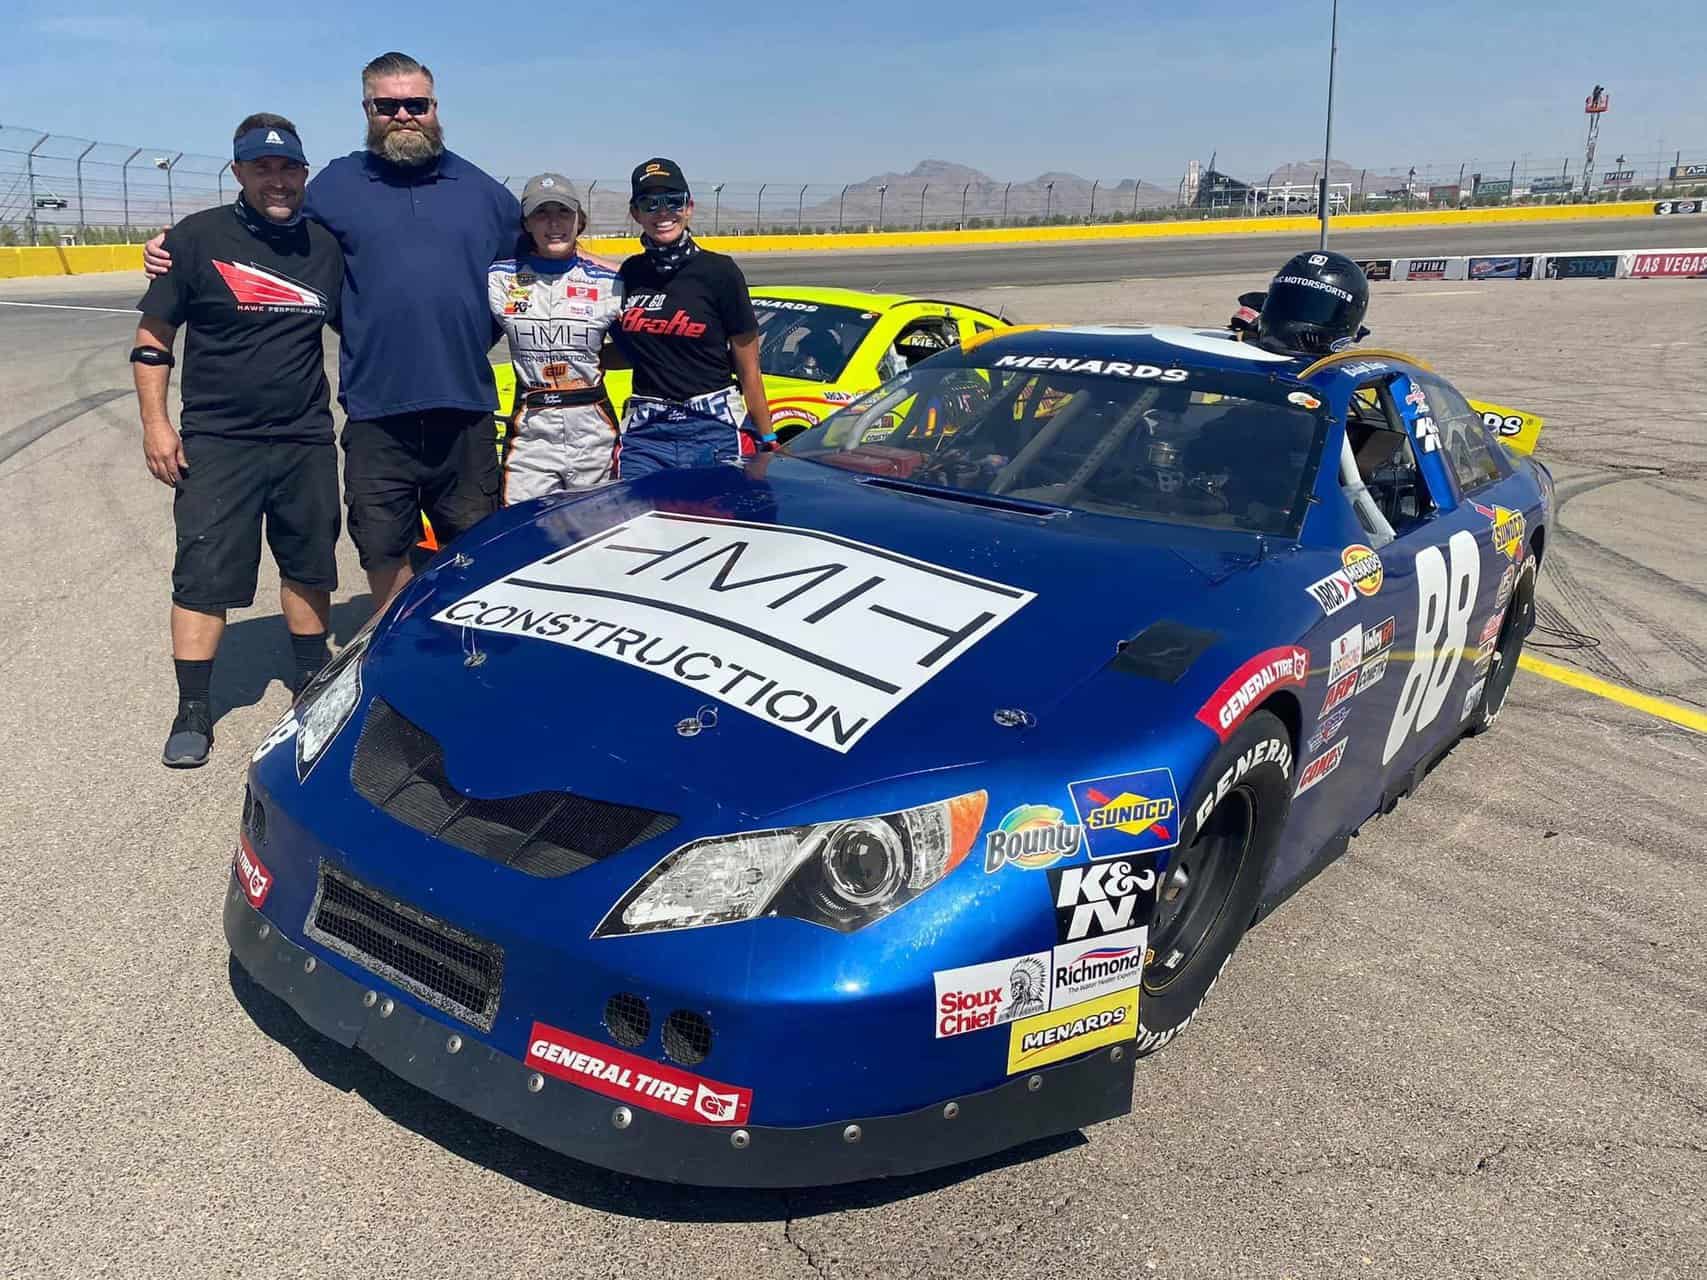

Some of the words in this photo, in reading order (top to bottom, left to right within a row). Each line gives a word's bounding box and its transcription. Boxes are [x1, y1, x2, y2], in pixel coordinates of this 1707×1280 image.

[1410, 260, 1446, 272] OPTIMA
[1567, 258, 1612, 273] STRAT
[1634, 256, 1660, 272] LAS
[1664, 254, 1707, 272] VEGAS
[1285, 276, 1347, 300] MOTORSPORTS
[751, 299, 819, 312] ENARDS
[513, 325, 589, 344] HMH
[994, 355, 1189, 382] MENARDS
[1495, 516, 1525, 547] SUNOCO
[1343, 555, 1381, 583] MENARDS
[545, 526, 996, 668] HMH
[1314, 578, 1345, 611] ARCA
[1382, 529, 1481, 766] 88
[445, 599, 869, 747] CONSTRUCTION
[1218, 660, 1276, 729] GENERAL
[1274, 656, 1295, 682] TIRE
[1196, 738, 1294, 833] GENERAL
[1090, 801, 1172, 829] SUNOCO
[985, 823, 1083, 873] Bounty
[1055, 945, 1141, 988] Richmond
[940, 986, 1003, 1014] Sioux
[939, 1008, 998, 1036] Chief
[1022, 1007, 1127, 1051] MENARDS
[530, 1039, 633, 1088] GENERAL
[634, 1073, 694, 1107] TIRE
